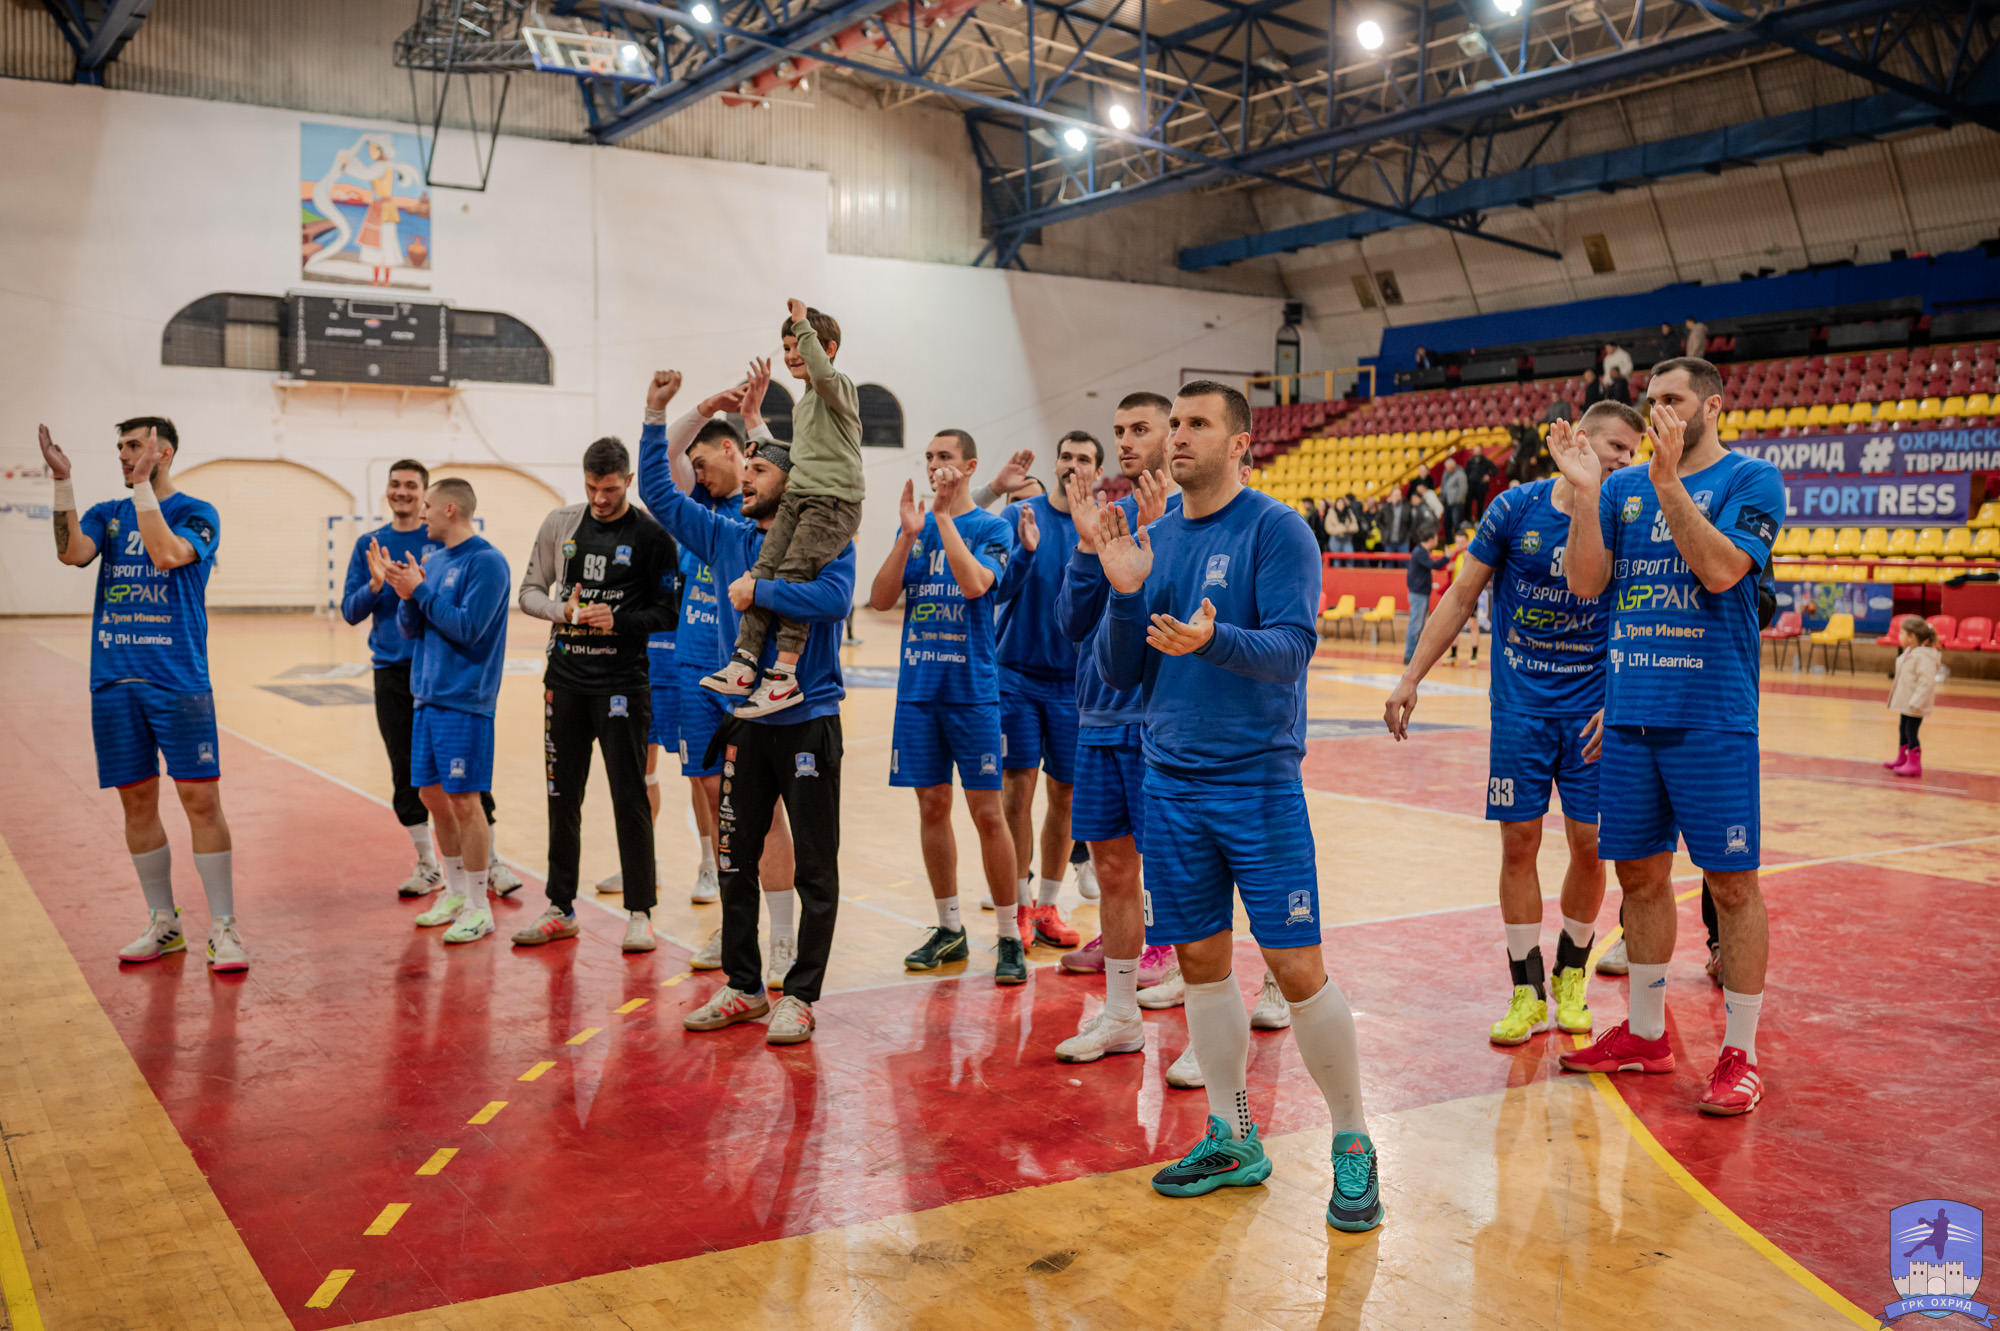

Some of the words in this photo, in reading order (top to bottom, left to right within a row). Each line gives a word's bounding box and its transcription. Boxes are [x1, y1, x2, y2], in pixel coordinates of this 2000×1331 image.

[1899, 428, 2000, 451] ОХРИДСК
[1765, 442, 1845, 472] ОХРИД
[1803, 483, 1957, 516] FORTRESS
[583, 554, 607, 581] 93
[929, 549, 946, 575] 14
[1550, 546, 1567, 577] 3
[1616, 584, 1701, 610] ASPPAK
[909, 603, 965, 621] ASPPAK
[1513, 605, 1596, 632] ASPPAK
[1526, 636, 1552, 650] Трпе
[1555, 641, 1594, 652] Инвест
[1626, 624, 1653, 640] Трпе
[1655, 624, 1705, 639] Инвест
[1527, 658, 1548, 672] LTH
[1551, 661, 1593, 673] Learnica
[1628, 653, 1648, 667] LTH
[1652, 653, 1703, 669] Learnica
[1489, 777, 1514, 807] 33
